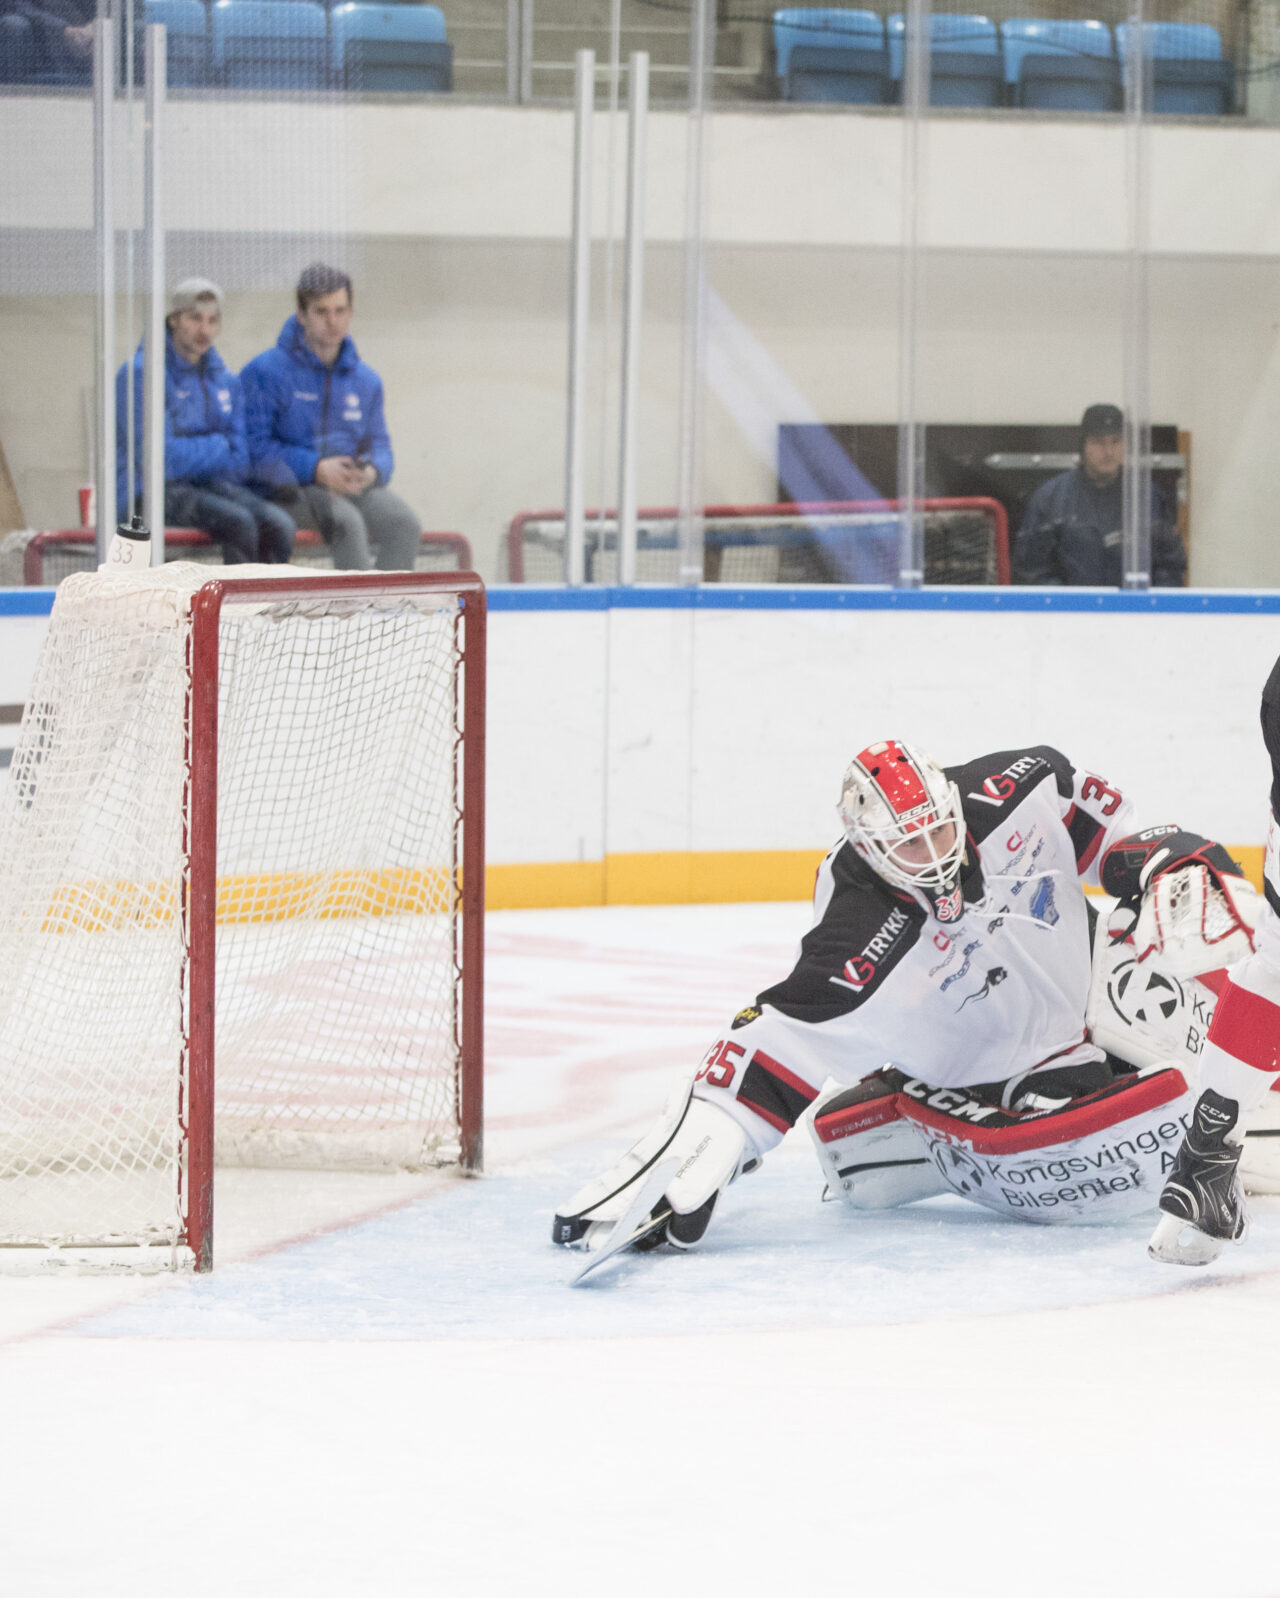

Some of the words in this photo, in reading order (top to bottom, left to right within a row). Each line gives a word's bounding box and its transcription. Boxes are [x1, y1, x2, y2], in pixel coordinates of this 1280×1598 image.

[111, 540, 135, 565] 33
[899, 801, 932, 821] CCM
[1139, 826, 1178, 841] CCM
[860, 906, 909, 962] TRYKK
[903, 1078, 1000, 1123] CCM
[1200, 1102, 1231, 1121] CCM
[831, 1113, 884, 1137] PREMIER
[676, 1135, 712, 1179] PREMIER
[989, 1112, 1189, 1186] Kongsvinger
[1000, 1167, 1141, 1208] Bilsenter
